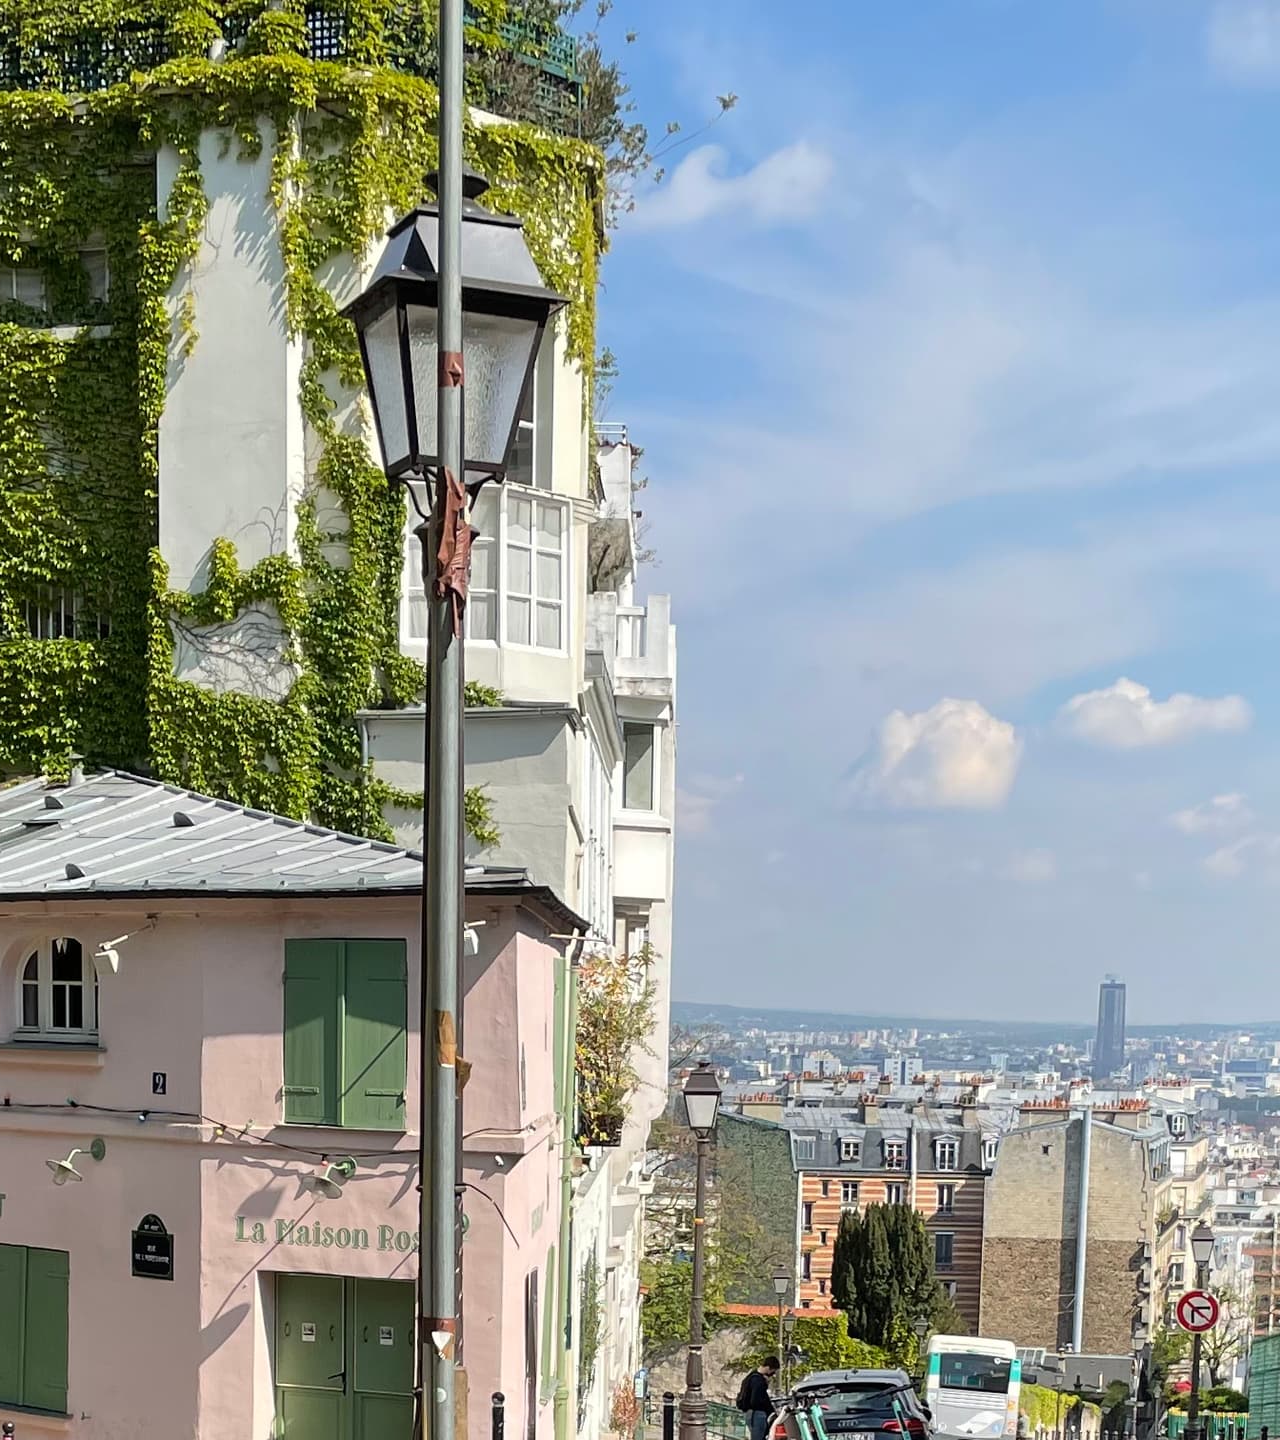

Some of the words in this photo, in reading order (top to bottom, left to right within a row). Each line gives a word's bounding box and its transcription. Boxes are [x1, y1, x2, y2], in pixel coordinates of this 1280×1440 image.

[155, 1073, 164, 1093] 2
[235, 1215, 267, 1244] La
[274, 1218, 370, 1250] Maison
